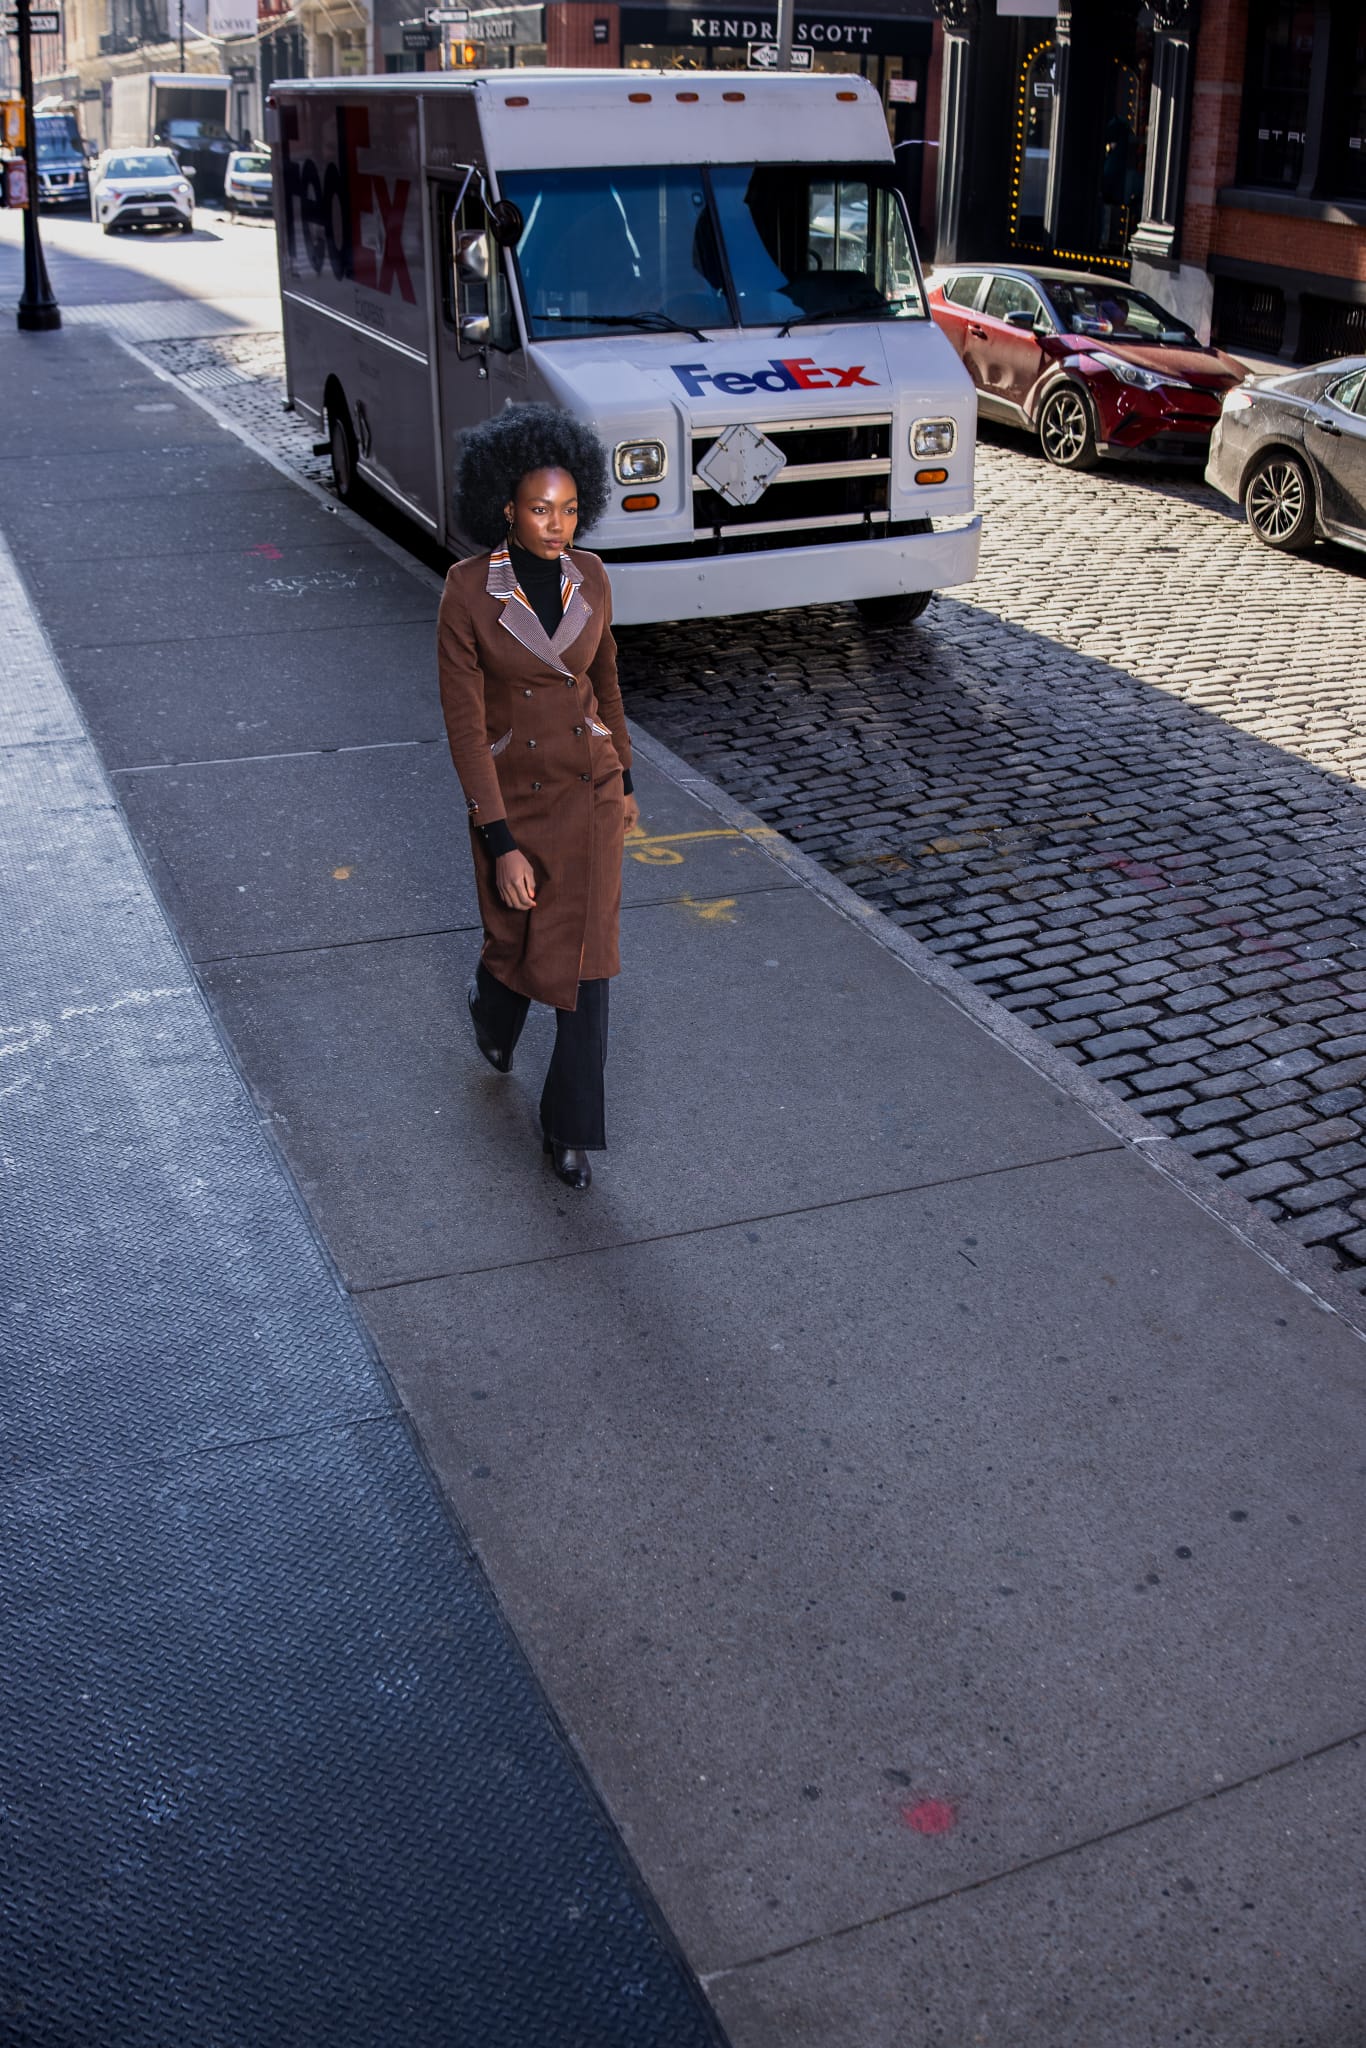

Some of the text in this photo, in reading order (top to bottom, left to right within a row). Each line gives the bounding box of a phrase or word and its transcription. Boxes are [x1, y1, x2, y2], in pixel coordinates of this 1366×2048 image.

[691, 18, 873, 44] KENDR SCOTT
[279, 104, 417, 306] FedEx
[670, 357, 880, 397] FedEx
